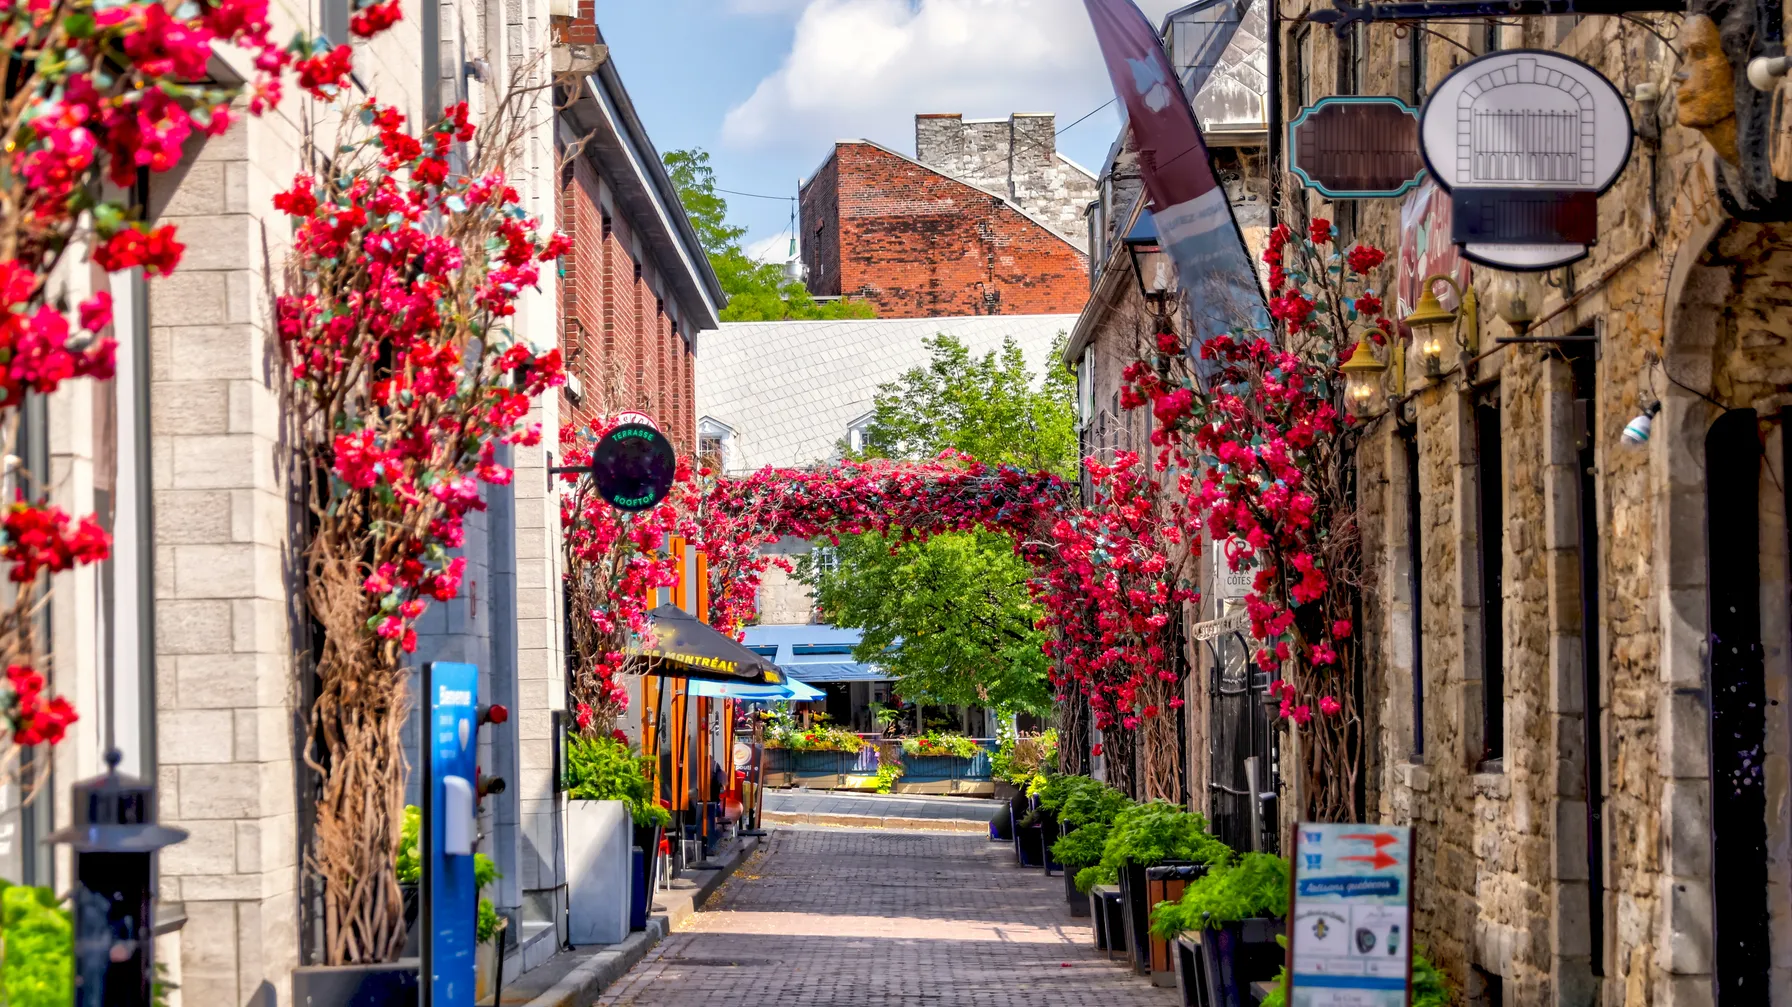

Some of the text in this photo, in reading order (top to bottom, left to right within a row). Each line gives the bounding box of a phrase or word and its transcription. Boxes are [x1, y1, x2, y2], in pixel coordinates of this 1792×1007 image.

[612, 429, 655, 442] TERRASSE
[613, 493, 655, 507] ROOFTOP
[1227, 575, 1252, 586] CÔTES
